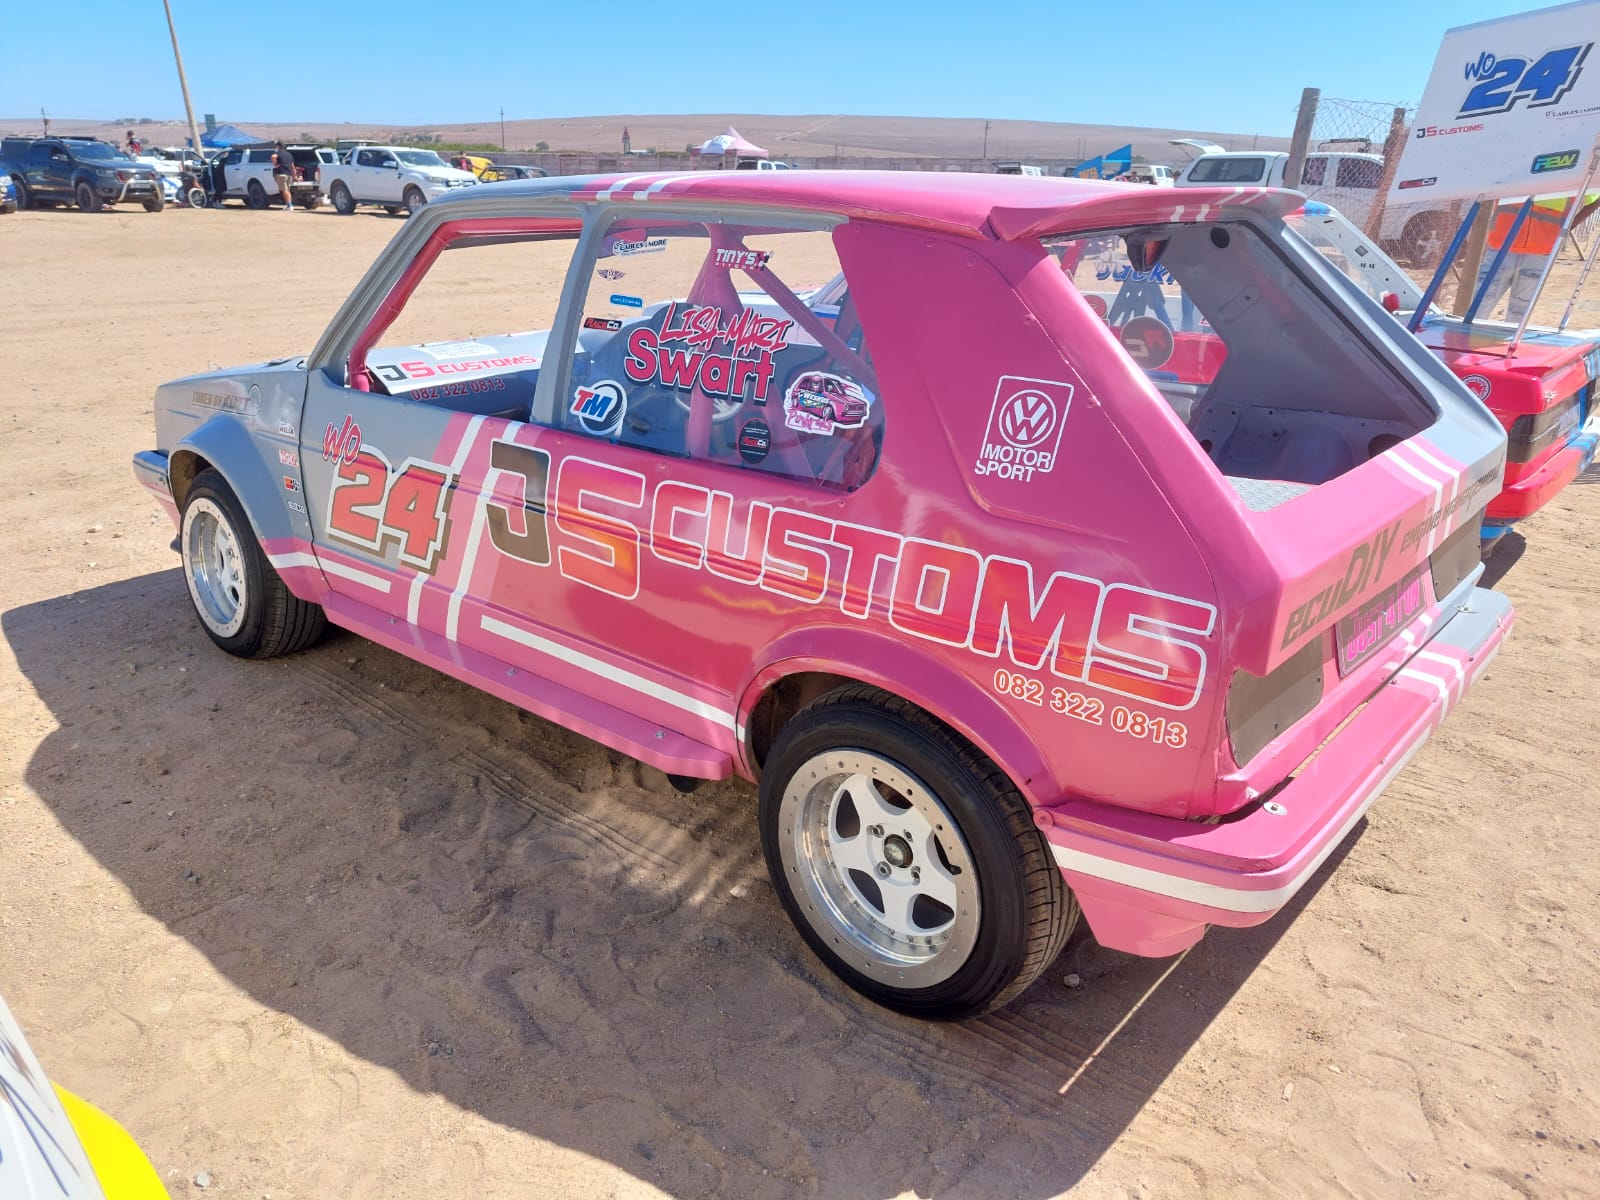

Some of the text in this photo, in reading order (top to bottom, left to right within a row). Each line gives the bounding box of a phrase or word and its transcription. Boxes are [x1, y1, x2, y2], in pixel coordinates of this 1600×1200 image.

[1457, 44, 1588, 117] 24
[1416, 124, 1485, 139] JS CUSTOMS
[716, 248, 757, 266] TINY'S
[375, 355, 538, 382] JS CUSTOMS
[625, 327, 775, 401] Swart
[410, 377, 506, 401] 082 322 0813
[572, 388, 614, 419] TM
[322, 414, 362, 464] WO
[984, 443, 1052, 469] MOTOR
[974, 459, 1037, 483] SPORT
[326, 444, 454, 571] 24
[487, 437, 1217, 711] JS CUSTOMS
[1280, 519, 1402, 652] ecuDIY
[993, 668, 1188, 749] 082 322 0813
